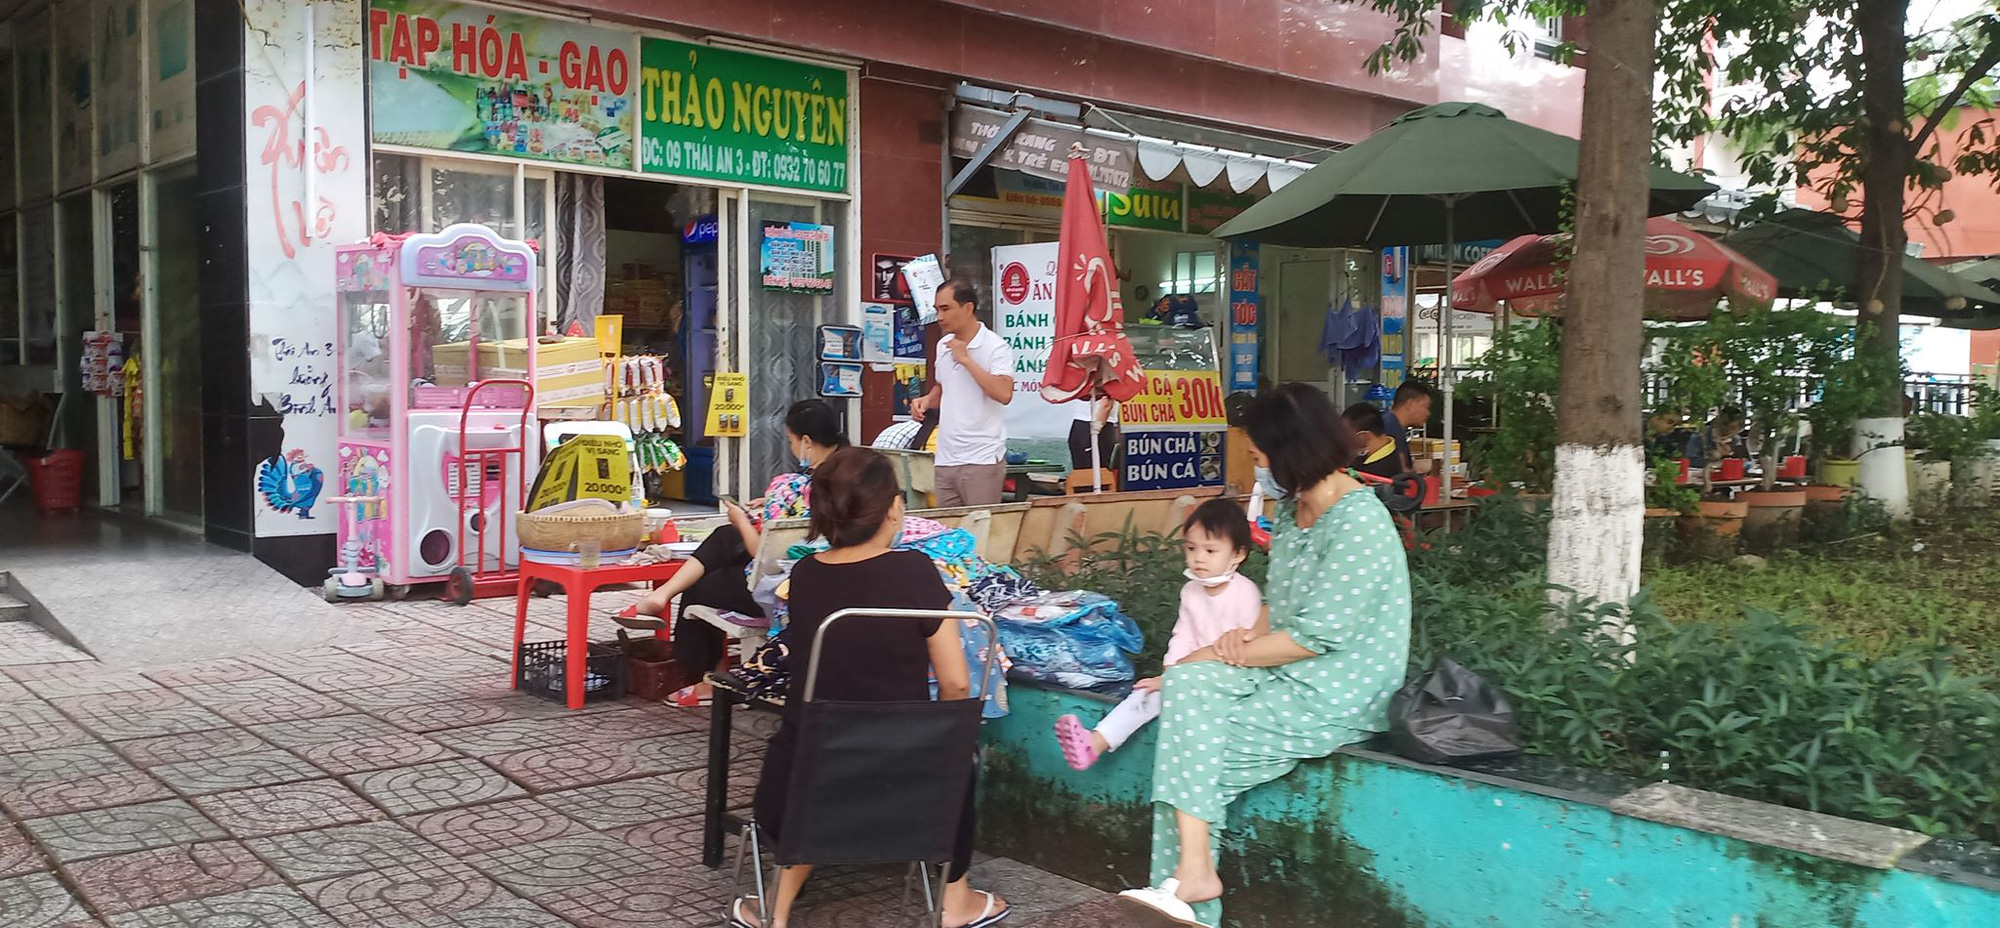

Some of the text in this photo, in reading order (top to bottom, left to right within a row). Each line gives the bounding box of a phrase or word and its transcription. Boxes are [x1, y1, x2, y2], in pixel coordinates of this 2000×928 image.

[370, 8, 628, 106] TẠP HÓA - GẠO
[641, 49, 846, 146] THẢO NGUYÊN
[1015, 132, 1057, 151] RANG
[642, 136, 663, 166] ĐC:
[666, 140, 681, 168] 09
[684, 136, 713, 172] THÁI
[716, 146, 733, 174] AN
[736, 149, 743, 175] 3
[752, 150, 771, 178] ĐT:
[773, 154, 801, 182] 0932
[803, 158, 816, 184] 70
[818, 159, 831, 186] 60
[833, 162, 846, 187] 77
[699, 222, 718, 238] pep
[1424, 244, 1461, 260] MILN
[1033, 278, 1053, 301] ĂN
[1005, 310, 1049, 328] BÁNH
[1233, 298, 1256, 325] TÓC
[325, 342, 334, 357] 3
[1153, 373, 1173, 396] CÁ
[1122, 397, 1176, 422] BÚN CHẢ
[1127, 431, 1197, 455] BÚN CHẢ
[1127, 457, 1196, 482] BÚN CÁ
